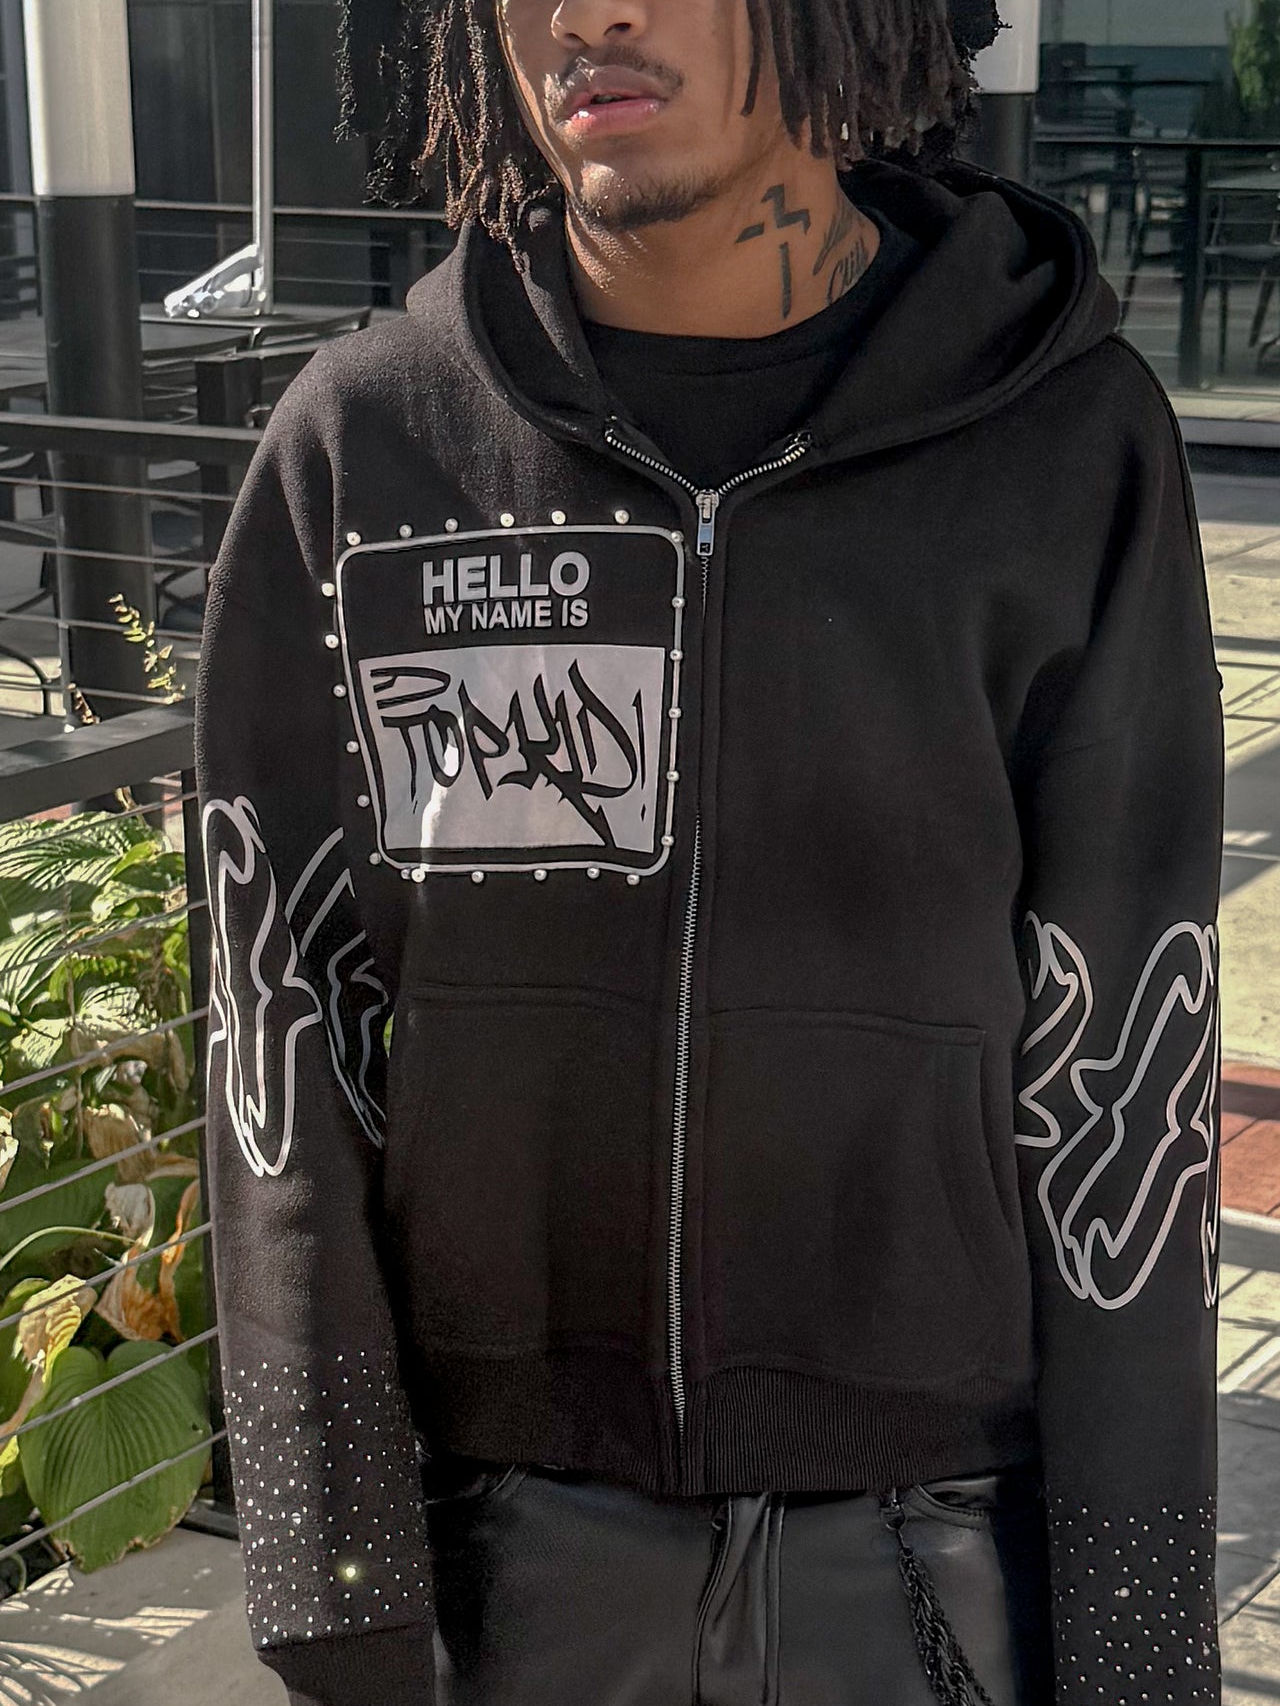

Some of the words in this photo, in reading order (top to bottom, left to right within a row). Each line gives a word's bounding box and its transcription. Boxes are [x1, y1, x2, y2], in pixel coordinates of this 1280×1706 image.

[423, 551, 591, 606] HELLO
[424, 604, 463, 635] MY
[472, 599, 553, 631] NAME
[562, 598, 589, 628] IS
